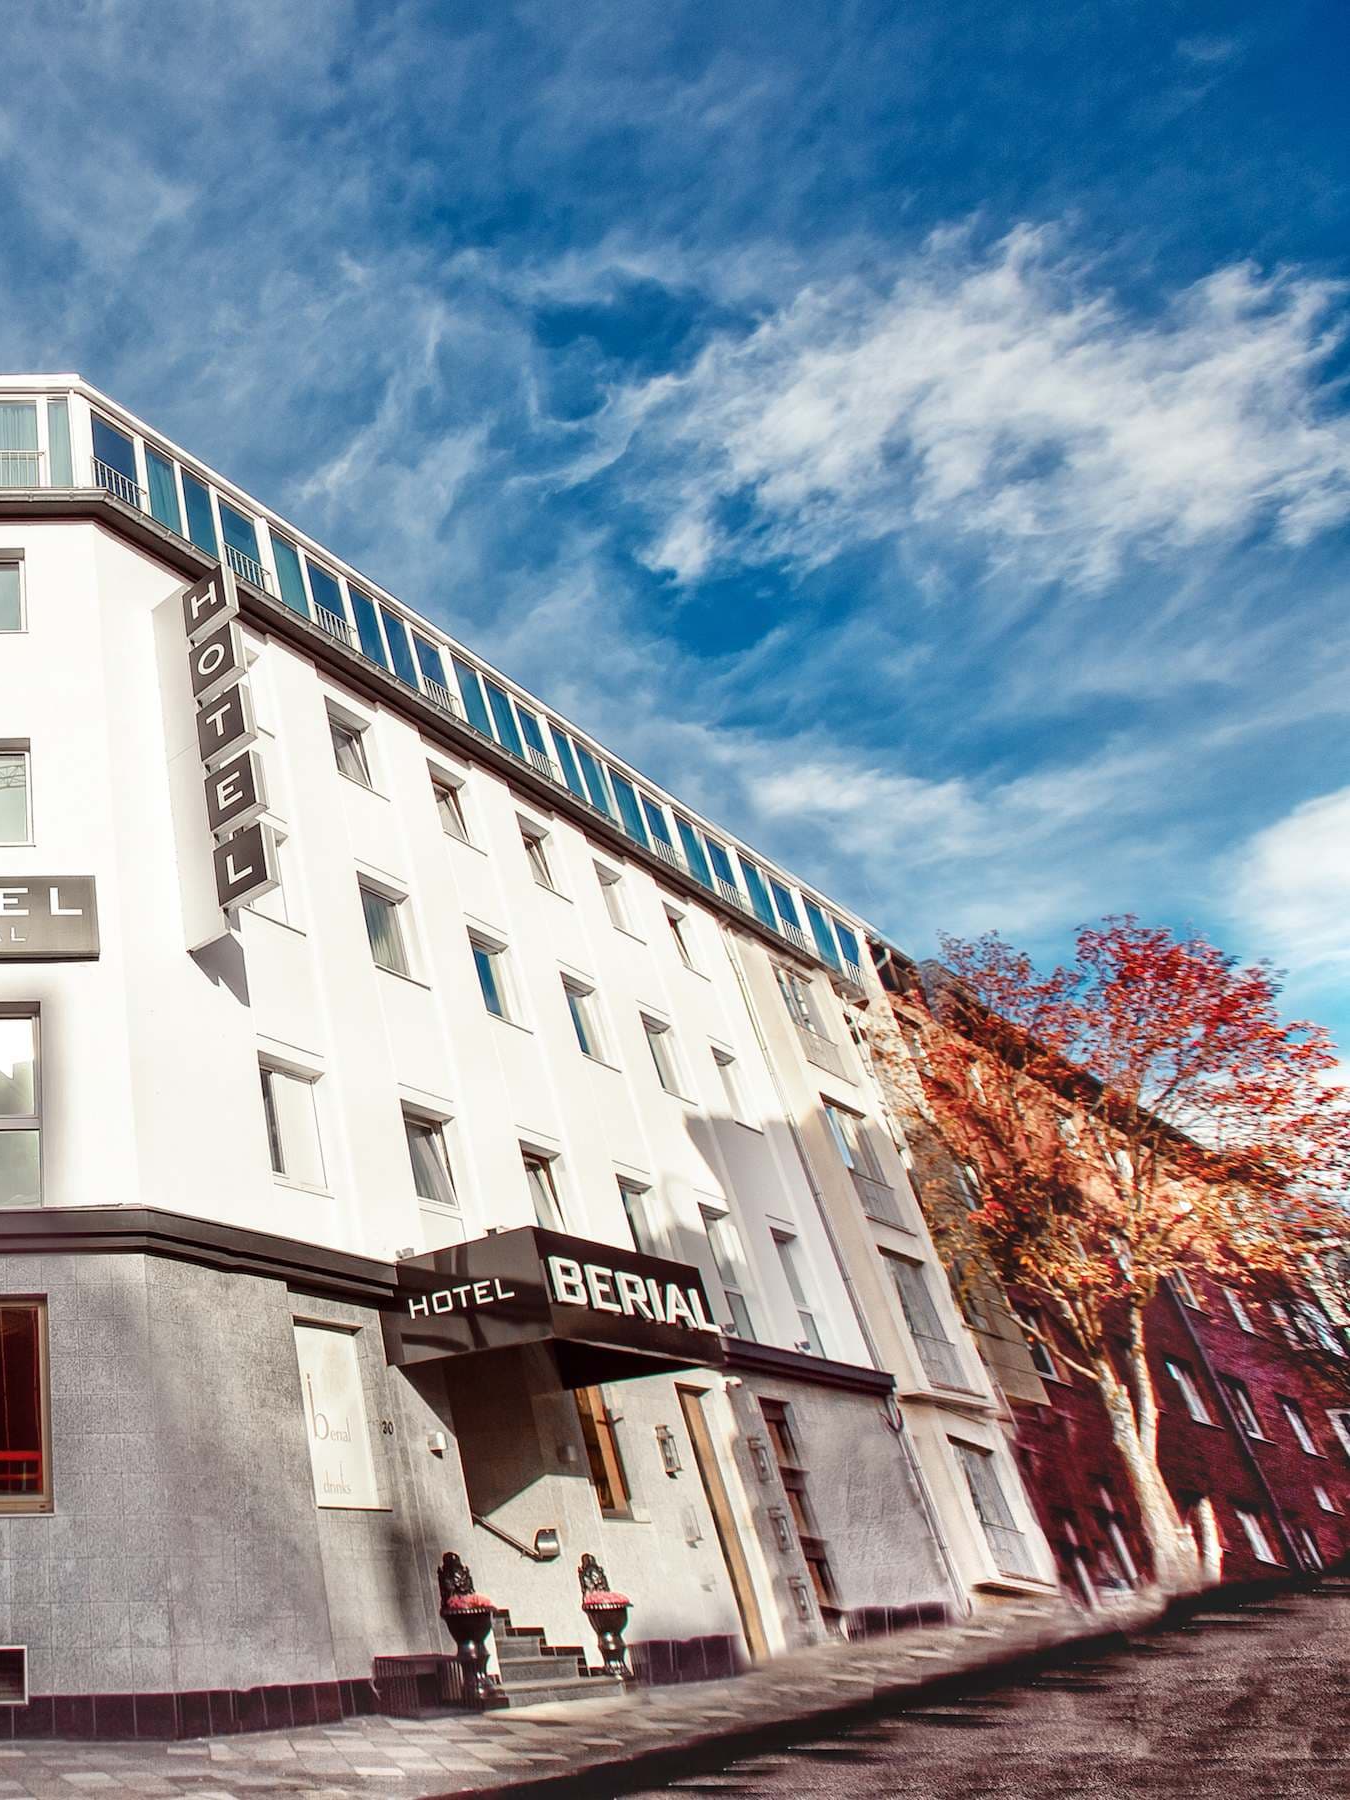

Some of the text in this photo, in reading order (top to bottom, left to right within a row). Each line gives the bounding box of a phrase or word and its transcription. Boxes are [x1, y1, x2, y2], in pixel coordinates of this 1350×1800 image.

[190, 580, 253, 886] HOTEL
[408, 1256, 722, 1333] HOTEL BERIAL
